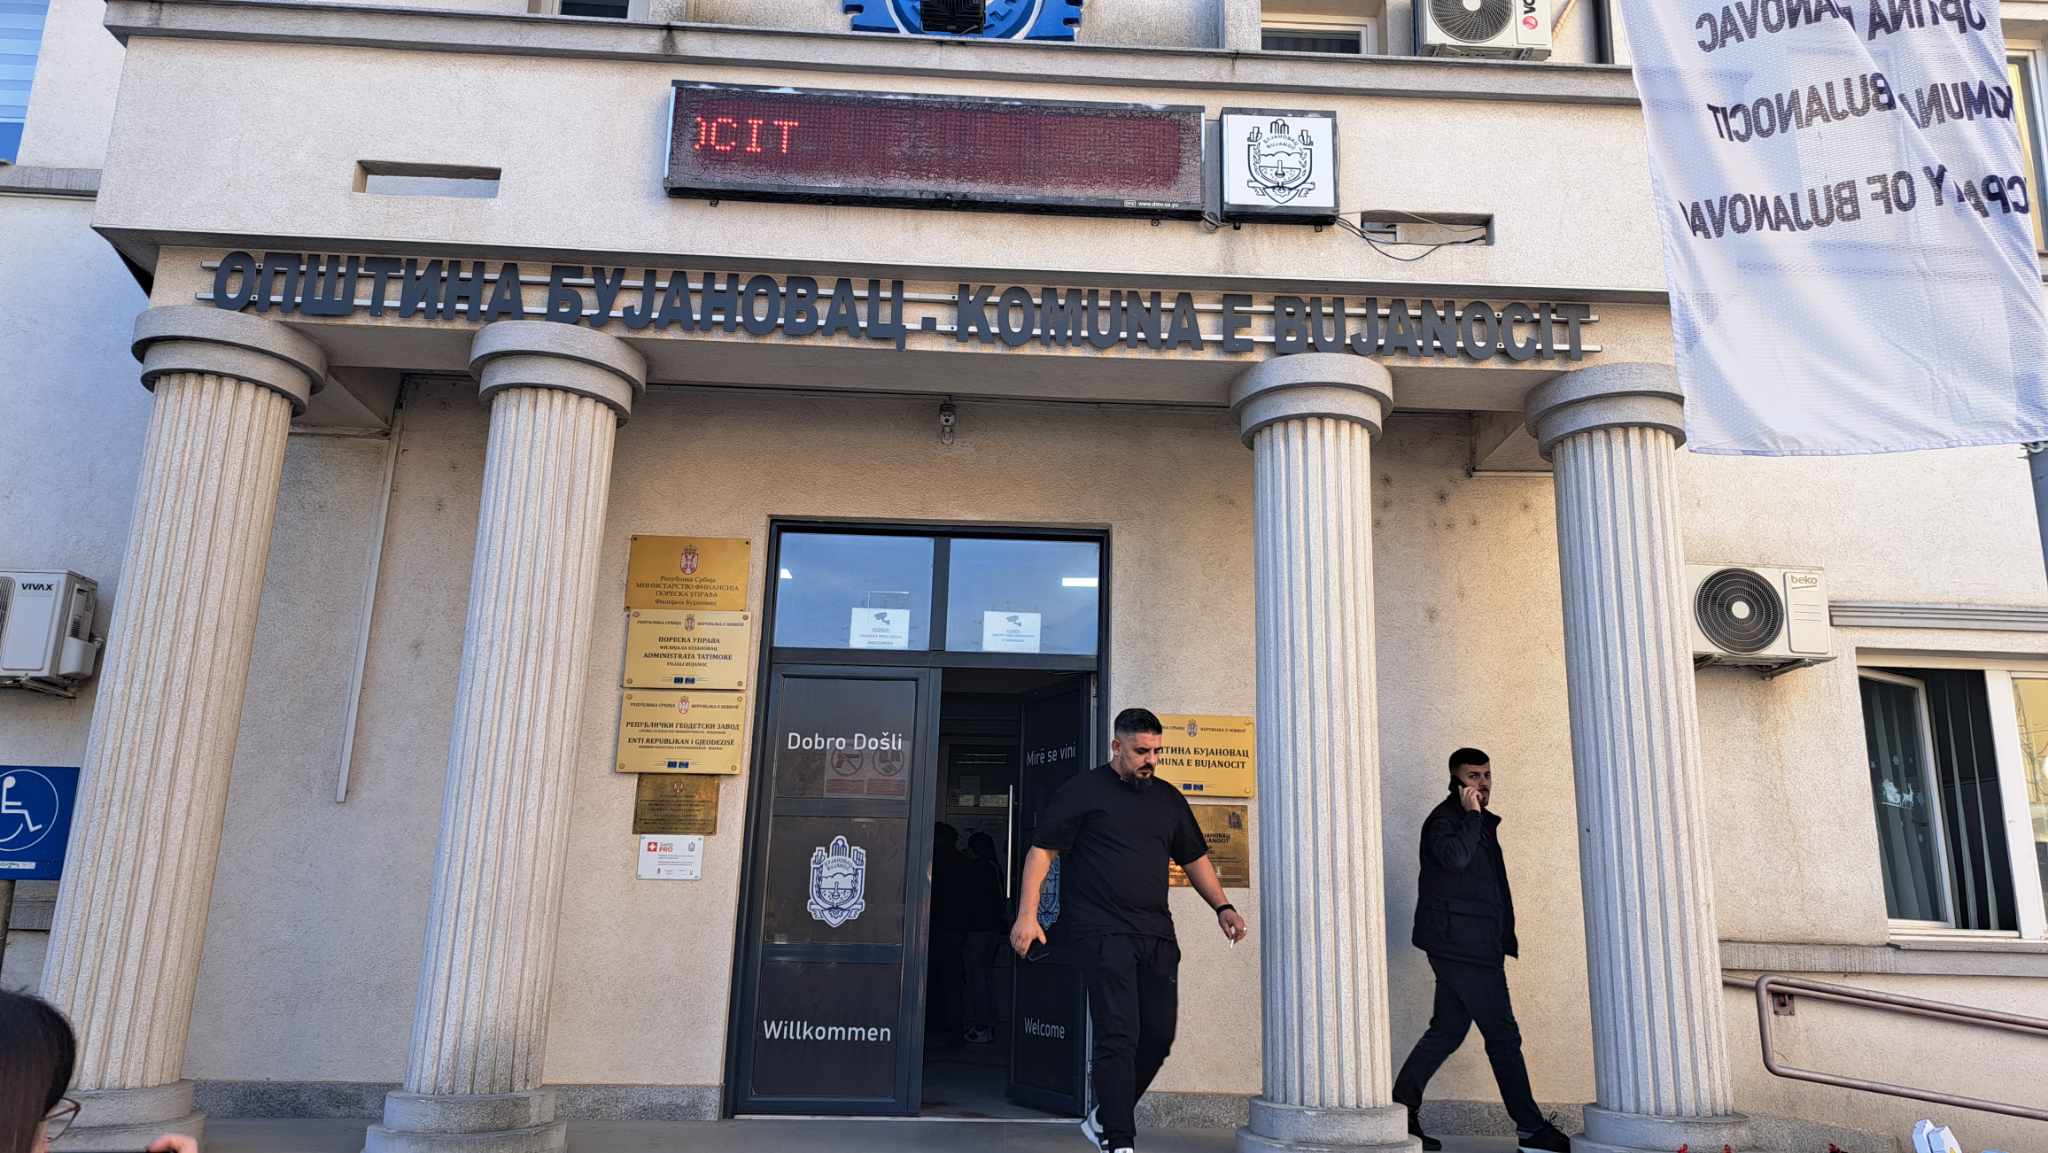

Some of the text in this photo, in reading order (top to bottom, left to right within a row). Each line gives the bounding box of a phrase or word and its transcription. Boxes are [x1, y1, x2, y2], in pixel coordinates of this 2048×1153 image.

[213, 250, 524, 321] ОПШТИНА
[546, 264, 906, 352] БУЈАНОВАЦ
[956, 284, 1204, 350] KOMUNA
[1222, 294, 1254, 353] E
[1274, 295, 1591, 361] BUJANOCIT
[21, 583, 54, 591] VIVAX
[1791, 575, 1817, 584] beko
[787, 732, 903, 750] Dobro Došli
[1025, 741, 1077, 767] Mirë se vini
[1158, 746, 1250, 758] ТИНА БУЈАНОВАЦ
[1186, 759, 1193, 767] E
[1194, 759, 1246, 769] BUJANOCIT
[763, 1020, 892, 1042] Willkommen
[1024, 1017, 1066, 1039] Welcome
